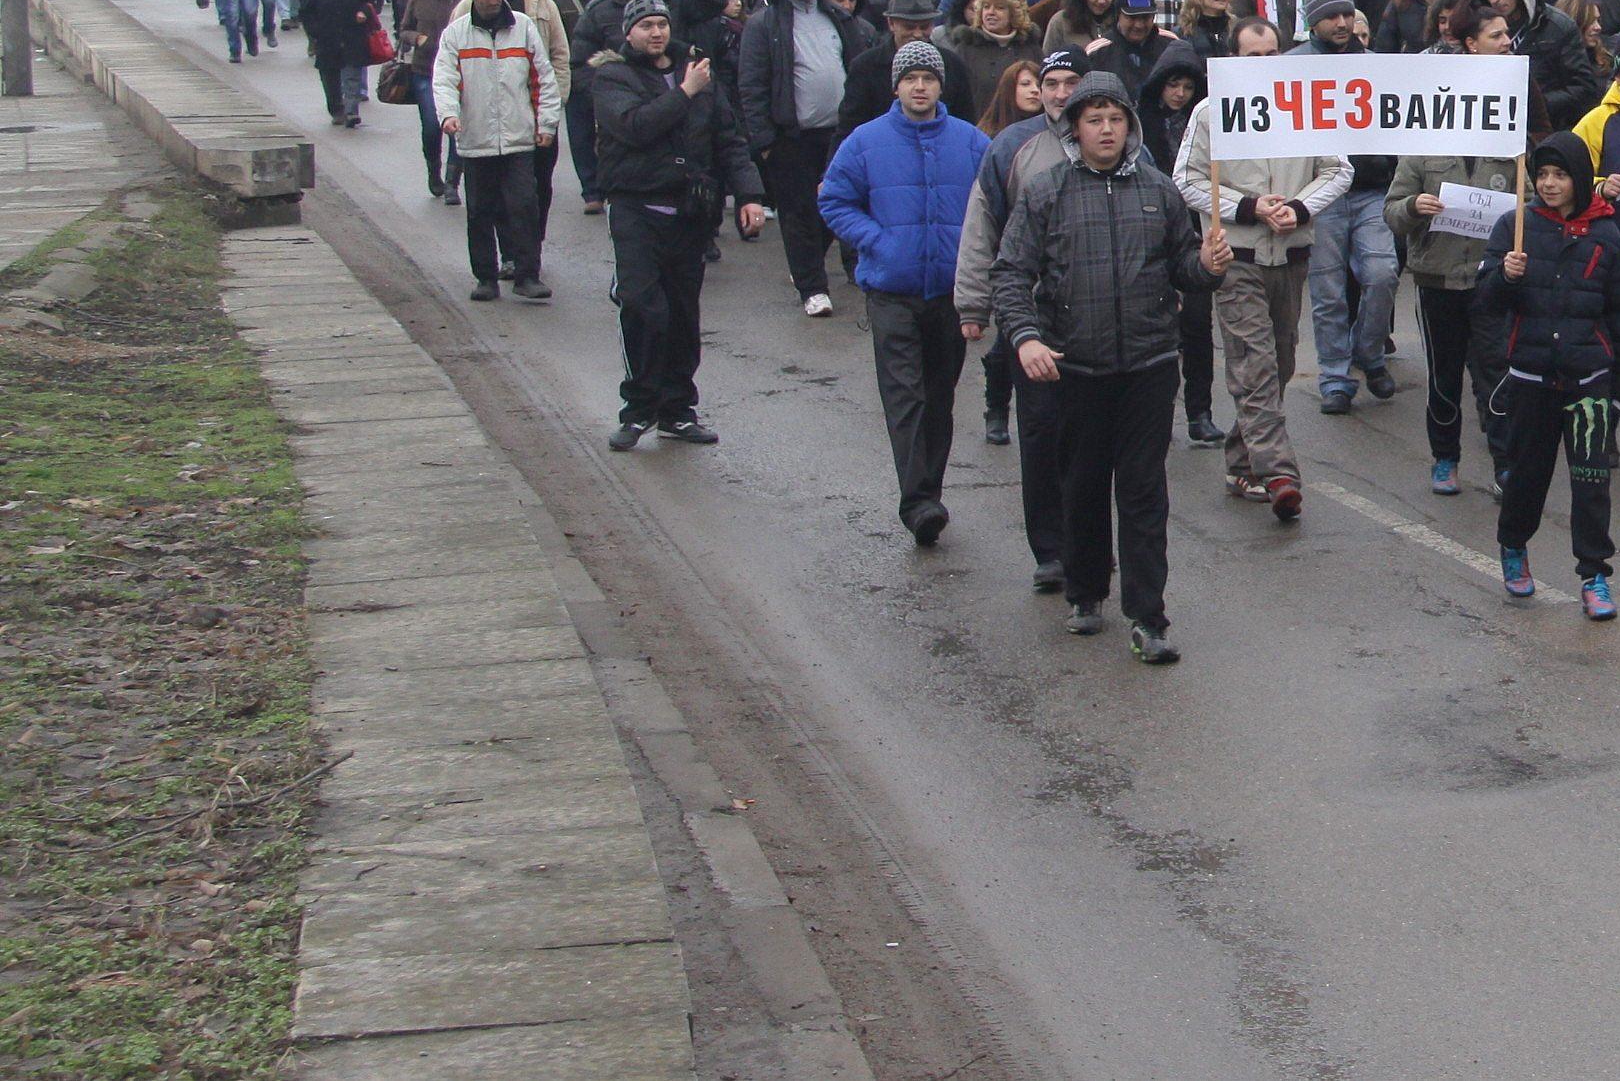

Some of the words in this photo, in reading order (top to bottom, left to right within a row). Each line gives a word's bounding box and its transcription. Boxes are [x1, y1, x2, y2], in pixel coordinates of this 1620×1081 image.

[1221, 78, 1518, 133] ИЗЧЕЗВАЙТЕ!
[1468, 191, 1492, 208] СЪД
[1469, 209, 1483, 220] ЗА
